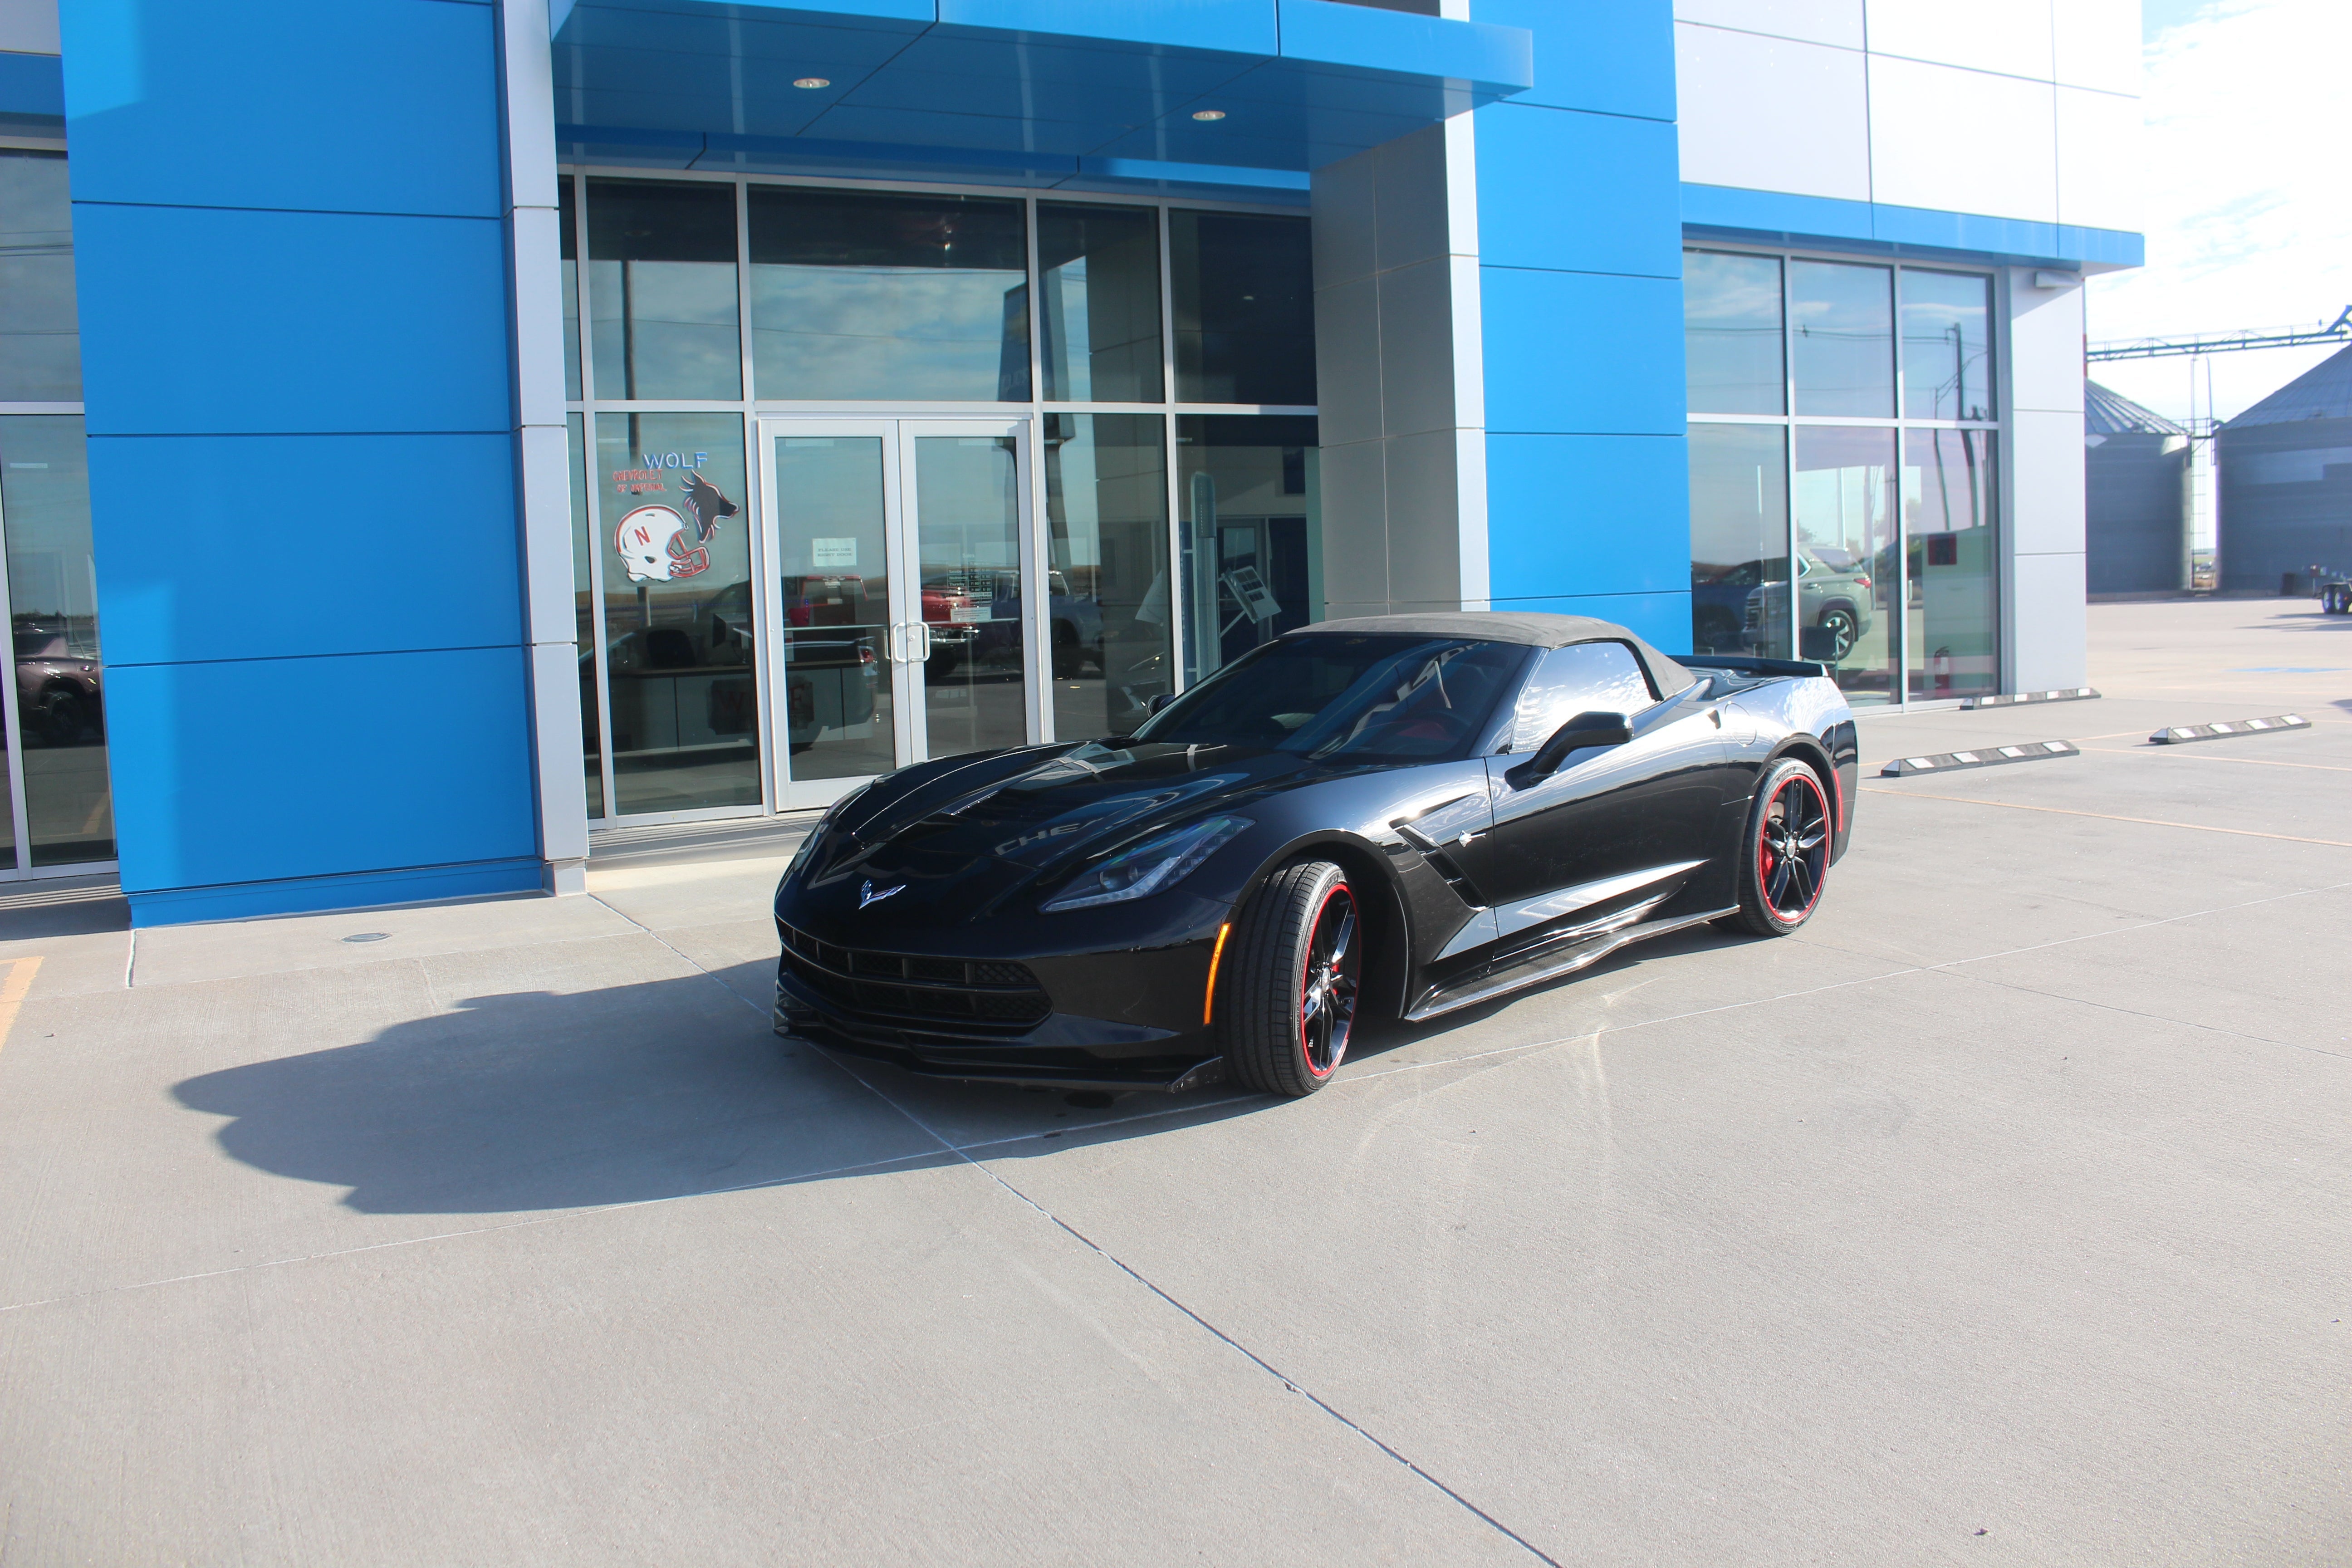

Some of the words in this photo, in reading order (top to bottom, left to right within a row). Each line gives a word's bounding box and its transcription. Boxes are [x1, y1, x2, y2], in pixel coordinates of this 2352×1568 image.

[643, 452, 707, 469] WOLF
[613, 470, 662, 481] CHEVROLET
[635, 526, 651, 546] N
